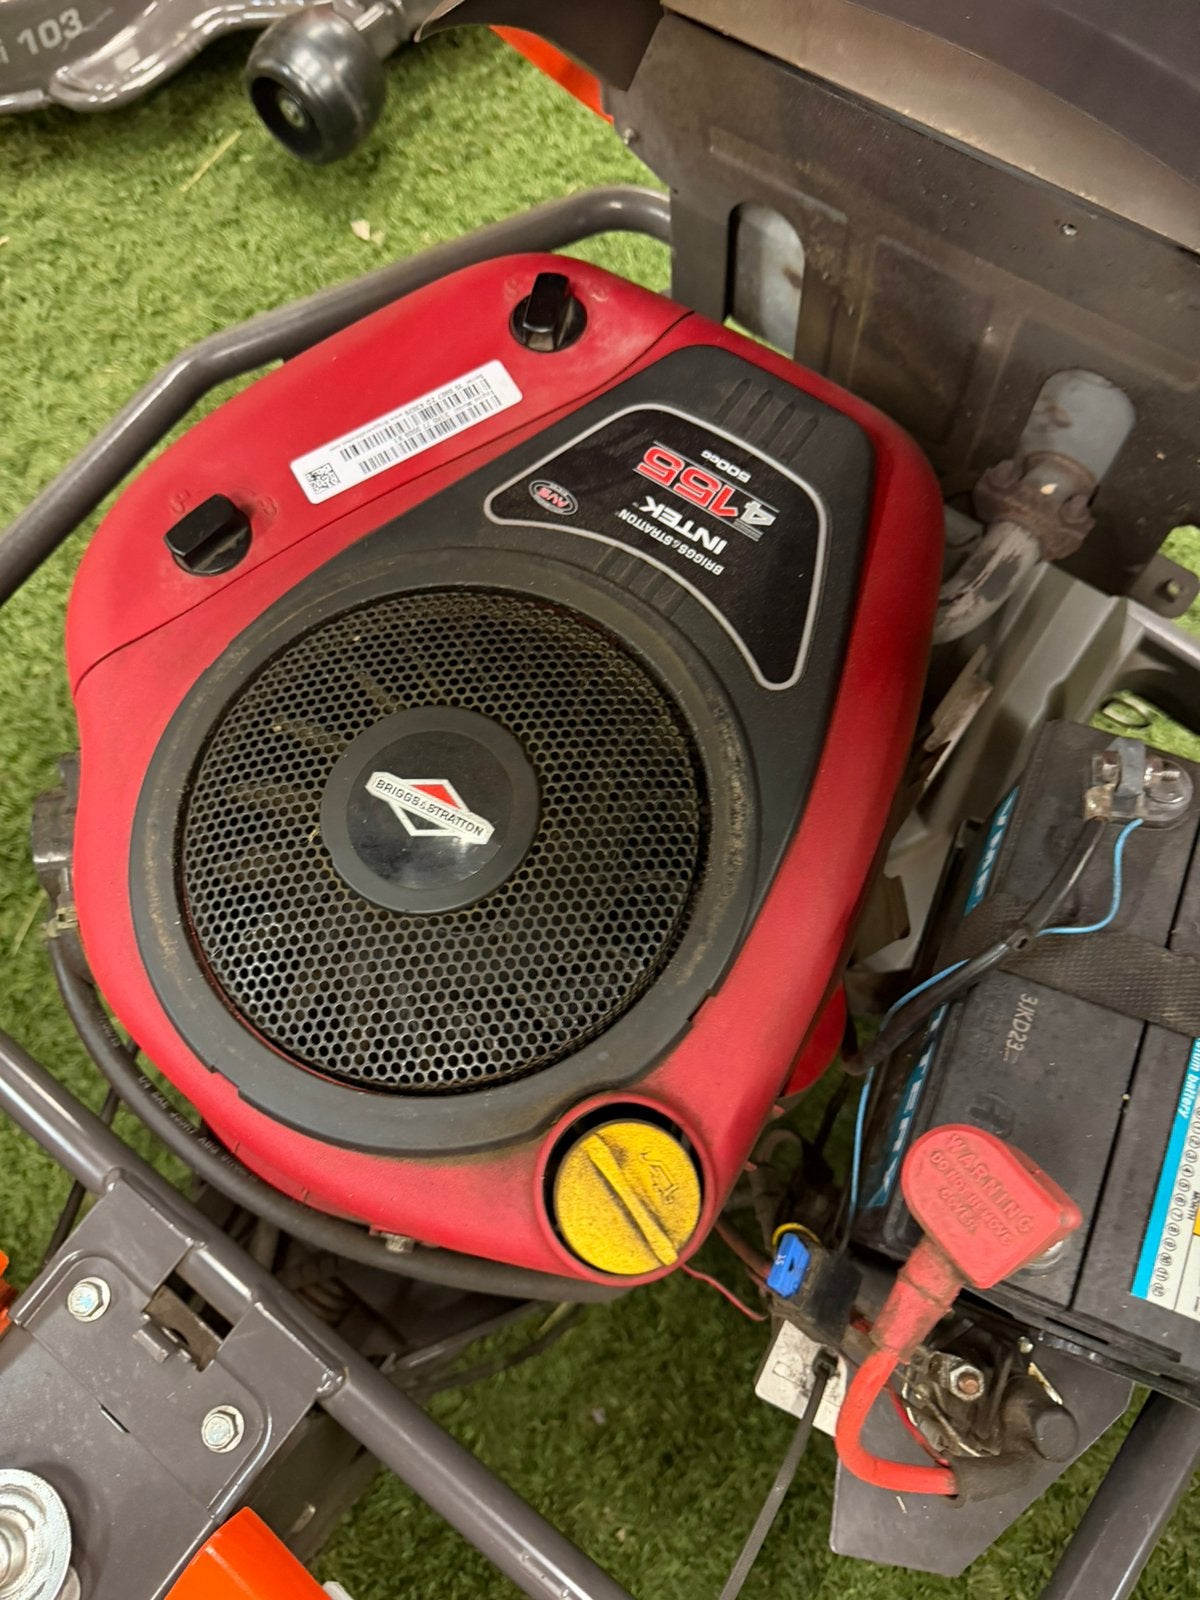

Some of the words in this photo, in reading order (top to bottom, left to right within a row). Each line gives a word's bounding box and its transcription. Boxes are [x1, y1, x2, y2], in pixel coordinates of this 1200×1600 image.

[17, 8, 84, 55] 103
[637, 446, 777, 527] 4155
[639, 495, 728, 555] INTEK
[374, 778, 485, 837] BRIGGS&STRATTON
[1177, 1073, 1200, 1119] battery
[929, 1150, 948, 1172] DO
[948, 1132, 1035, 1234] WARNING
